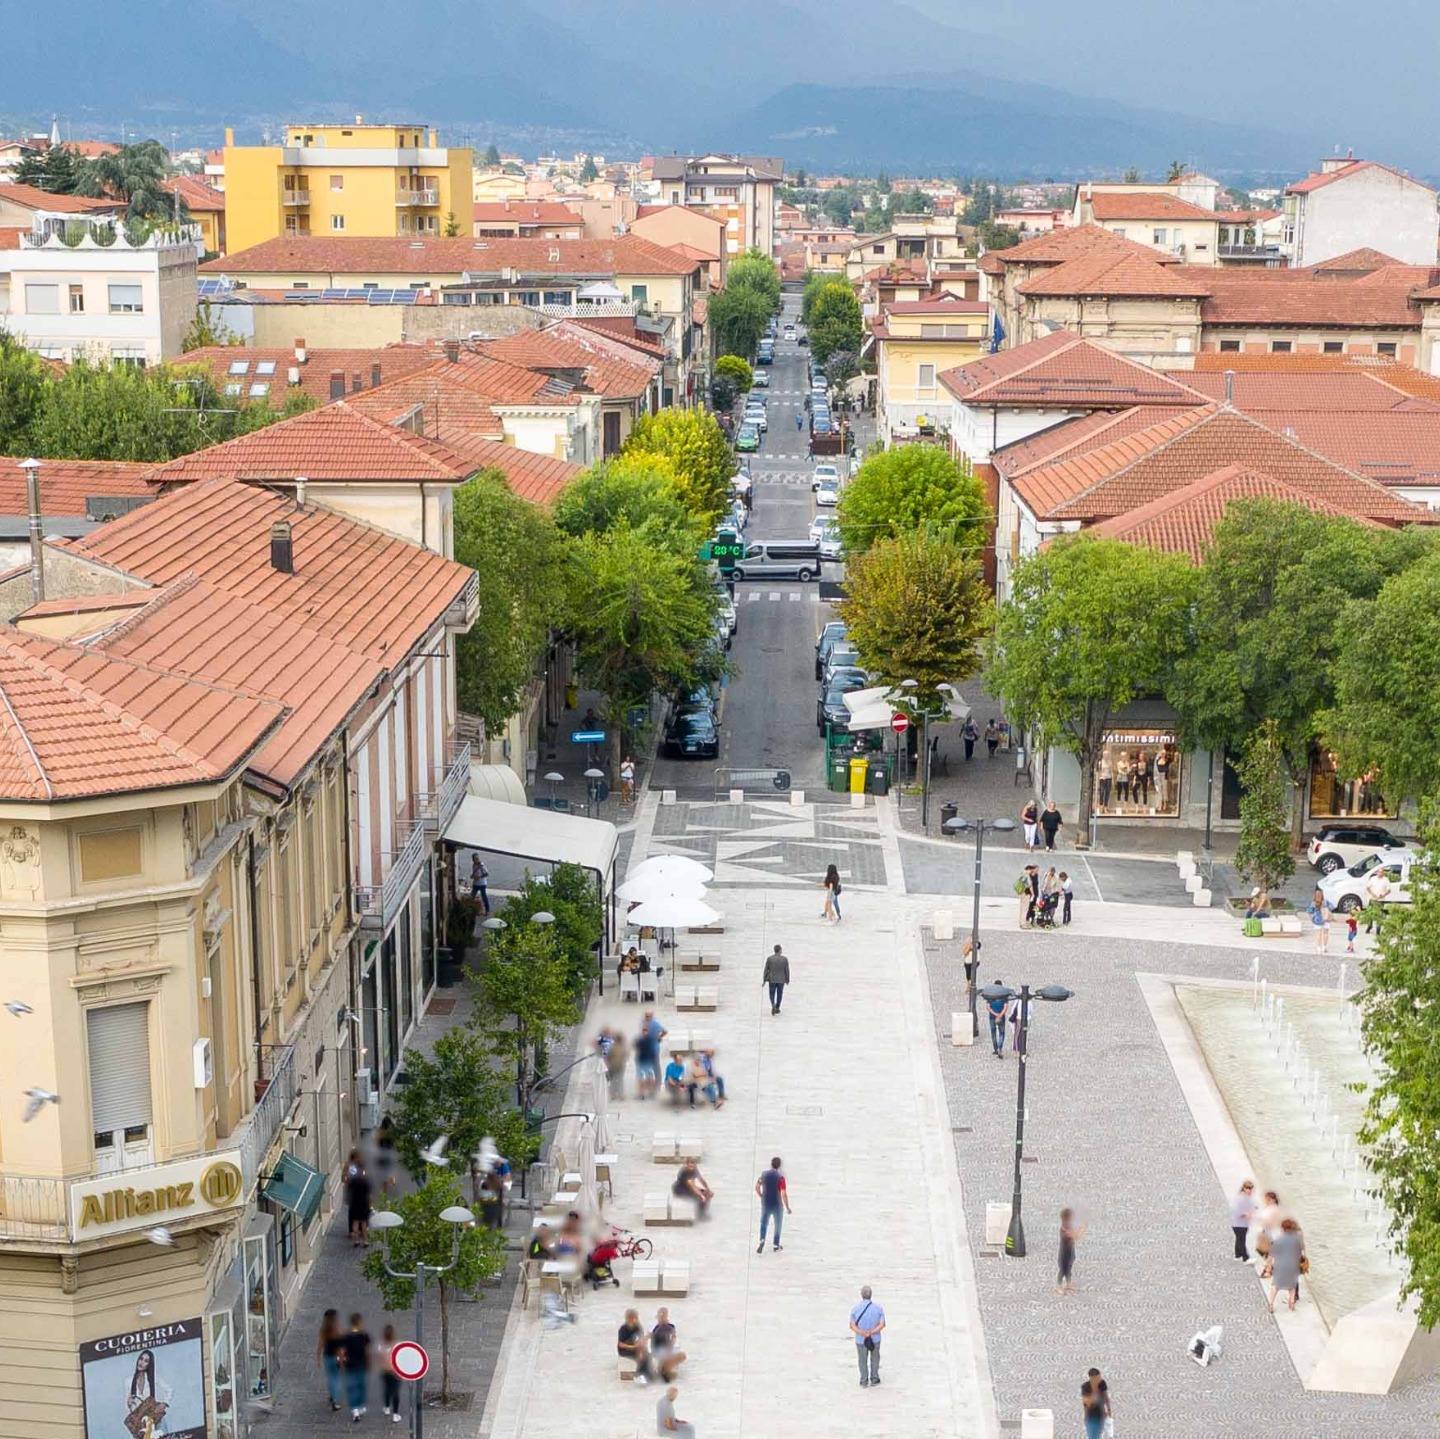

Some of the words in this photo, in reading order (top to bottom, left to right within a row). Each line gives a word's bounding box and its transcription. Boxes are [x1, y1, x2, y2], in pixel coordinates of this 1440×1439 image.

[79, 1181, 195, 1228] Allianz
[94, 1324, 186, 1351] CUOIERIA
[116, 1338, 167, 1354] FIORENTINA
